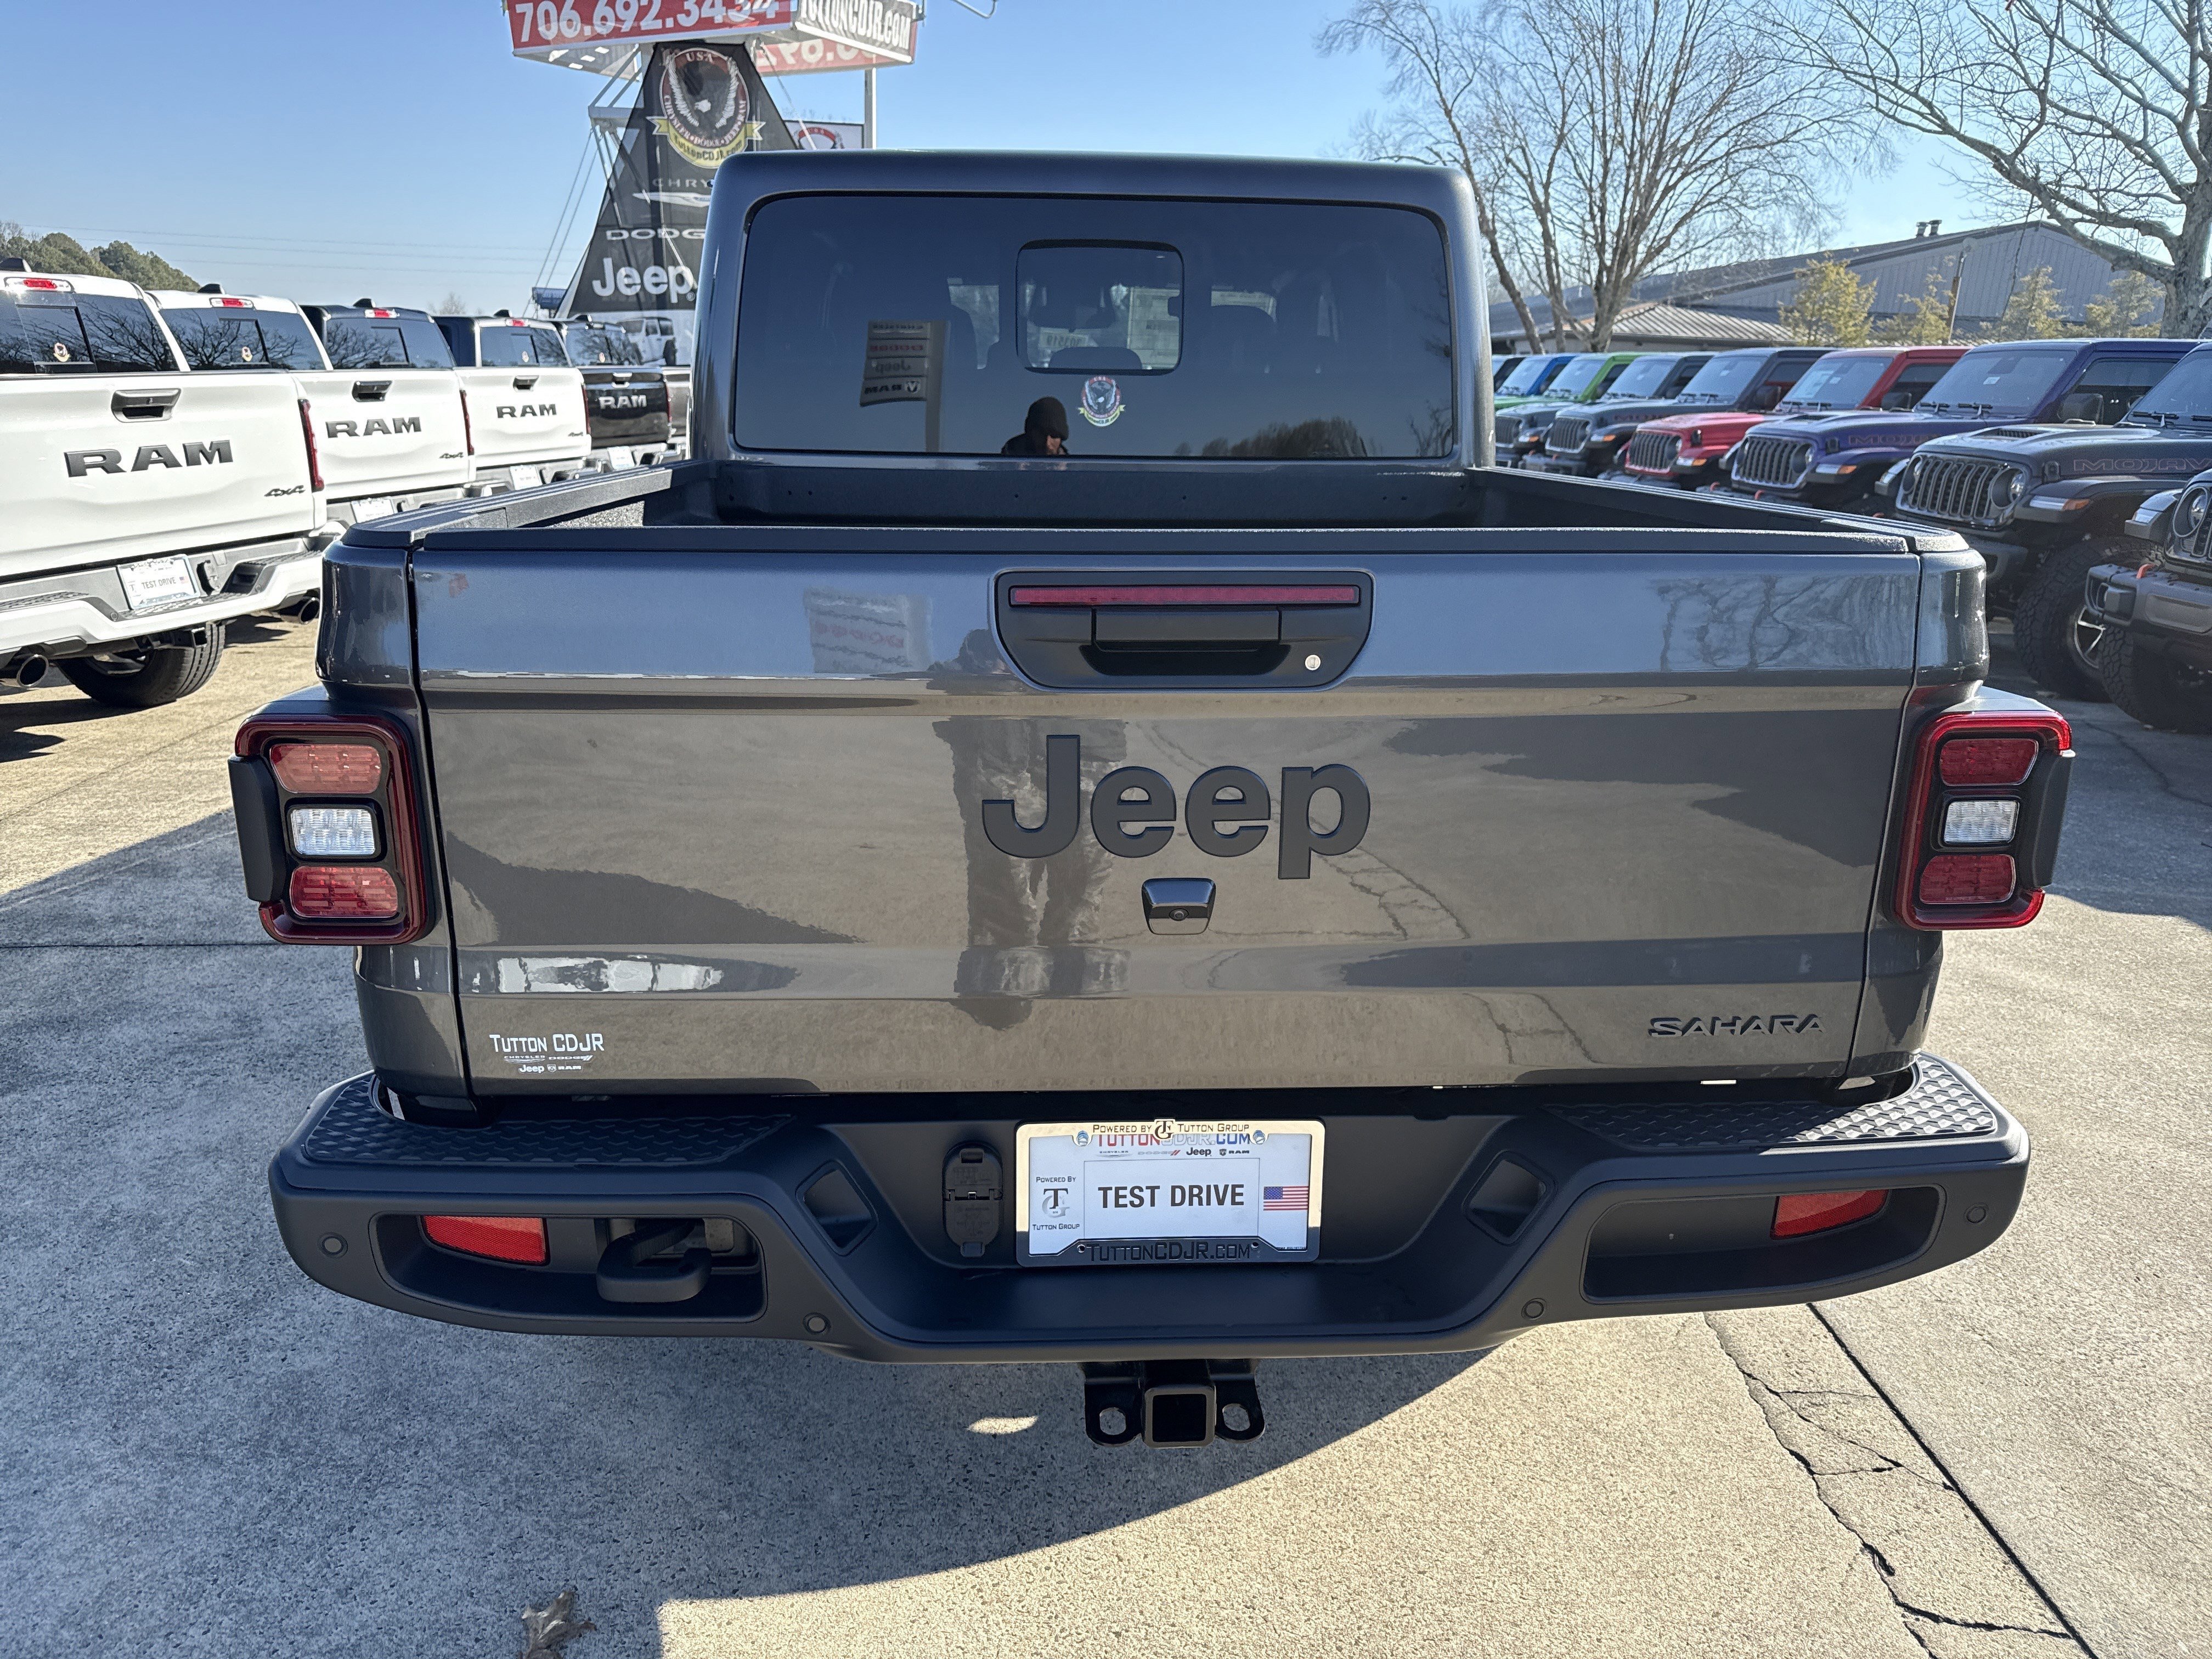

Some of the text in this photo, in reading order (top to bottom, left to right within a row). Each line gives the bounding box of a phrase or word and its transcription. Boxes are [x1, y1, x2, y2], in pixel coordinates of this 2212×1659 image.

[686, 52, 714, 62] USA
[592, 257, 695, 303] Jeep
[497, 404, 557, 418] RAM
[599, 394, 647, 409] RAM
[325, 417, 421, 438] RAM
[64, 439, 234, 478] RAM
[141, 577, 177, 589] TEST DRIVE
[982, 735, 1370, 879] Jeep
[1649, 1014, 1825, 1037] SAHARA
[489, 1033, 605, 1052] TUTTON CDJR
[519, 1064, 545, 1074] Jeep
[1093, 1124, 1137, 1133] POWERED
[1141, 1124, 1152, 1132] BY
[1177, 1124, 1214, 1133] TUTTON
[1217, 1123, 1250, 1132] GROUP
[1186, 1147, 1211, 1156] Jeep
[1098, 1184, 1245, 1209] TEST DRIVE
[1087, 1242, 1251, 1261] TUTTONCDJR.COM
